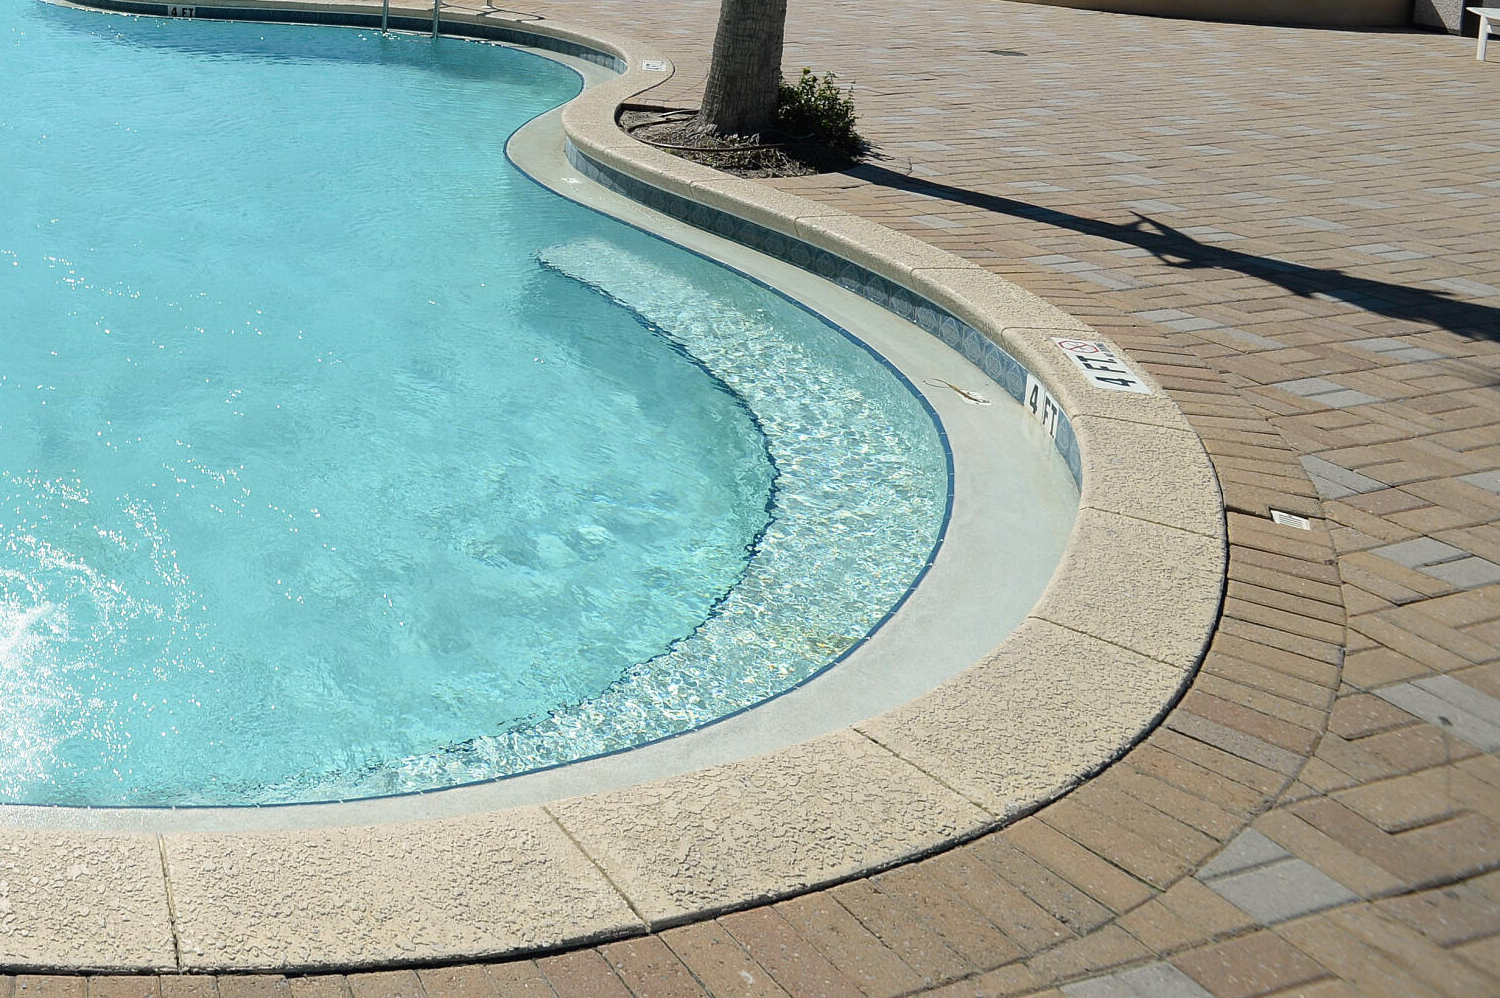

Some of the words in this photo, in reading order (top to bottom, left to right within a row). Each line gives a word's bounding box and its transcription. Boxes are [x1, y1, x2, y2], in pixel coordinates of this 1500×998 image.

[171, 6, 178, 18] 4
[1094, 376, 1137, 387] 4
[1029, 383, 1039, 416] 4
